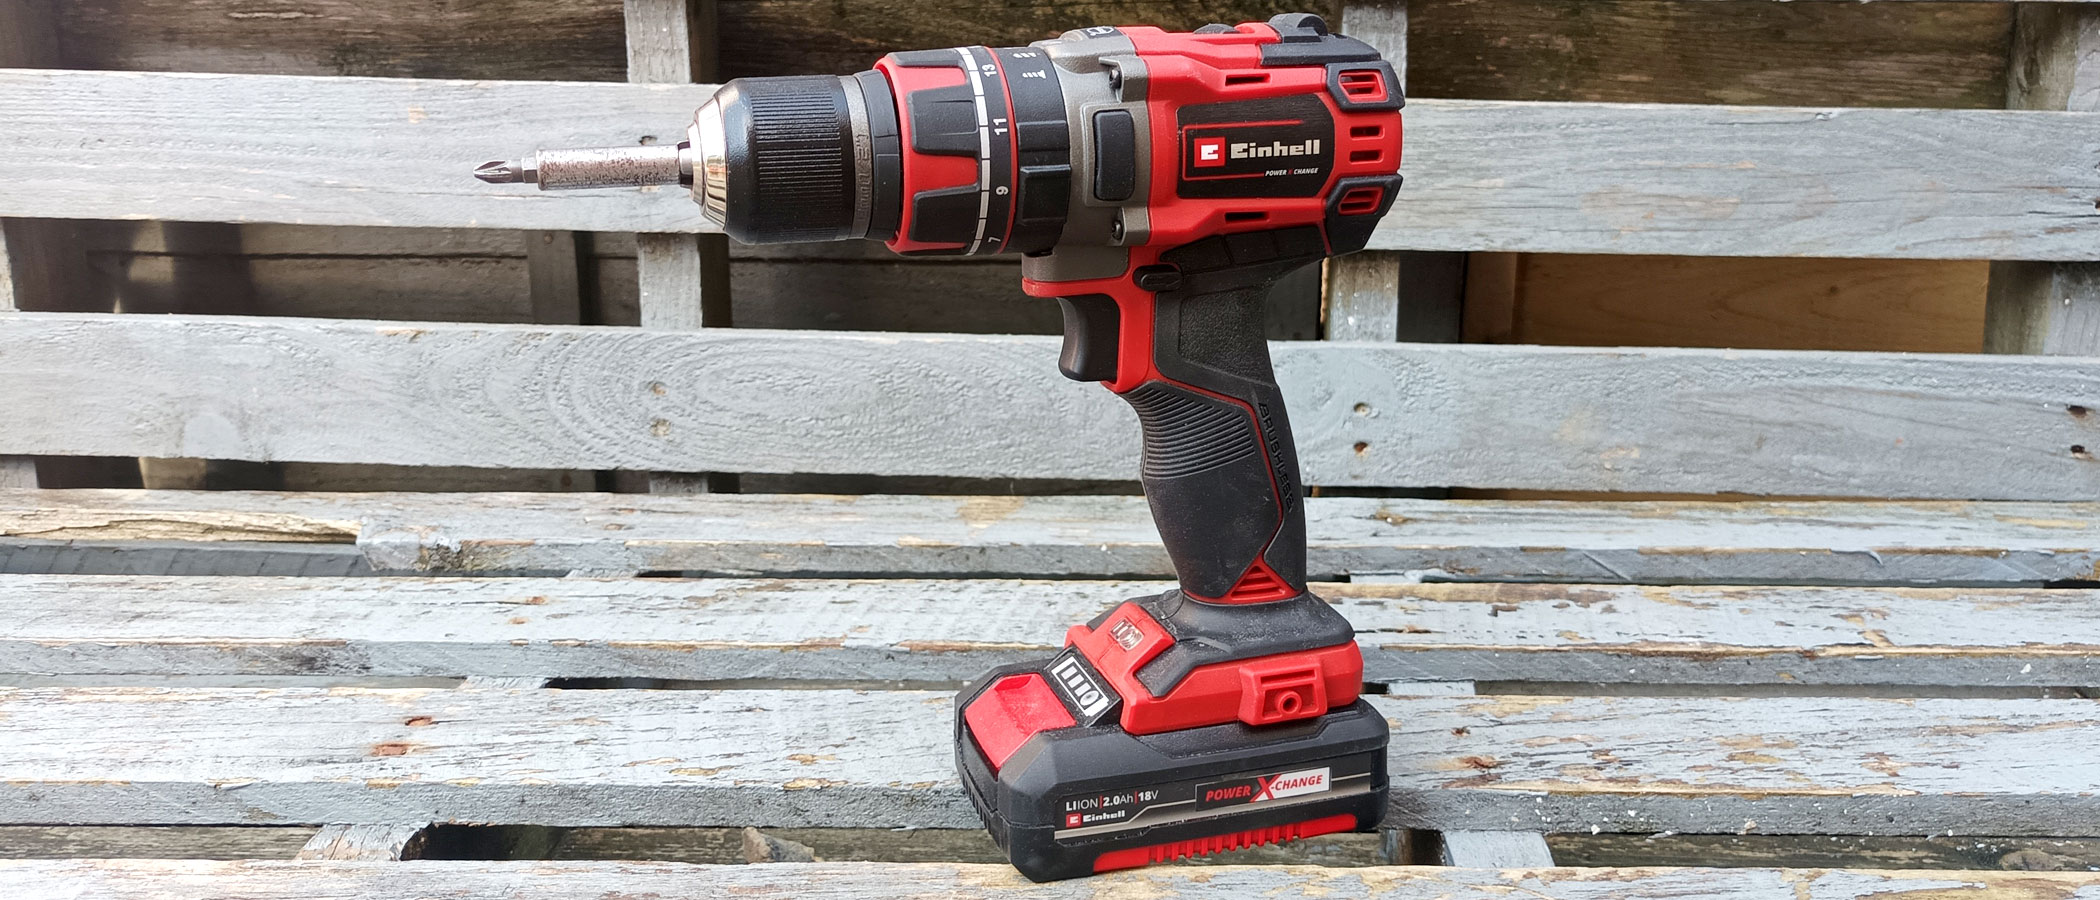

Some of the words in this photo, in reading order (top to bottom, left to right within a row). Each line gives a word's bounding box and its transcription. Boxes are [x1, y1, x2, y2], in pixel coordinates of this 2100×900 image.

[981, 64, 998, 78] 13
[992, 118, 1009, 136] 11
[1230, 139, 1320, 159] Einhell
[1265, 169, 1287, 177] POWER
[1293, 167, 1319, 175] CHANGE
[995, 185, 1009, 196] 9
[1258, 402, 1295, 512] BRUSHLESS
[1205, 785, 1252, 802] POWER
[1082, 810, 1126, 823] Einhell
